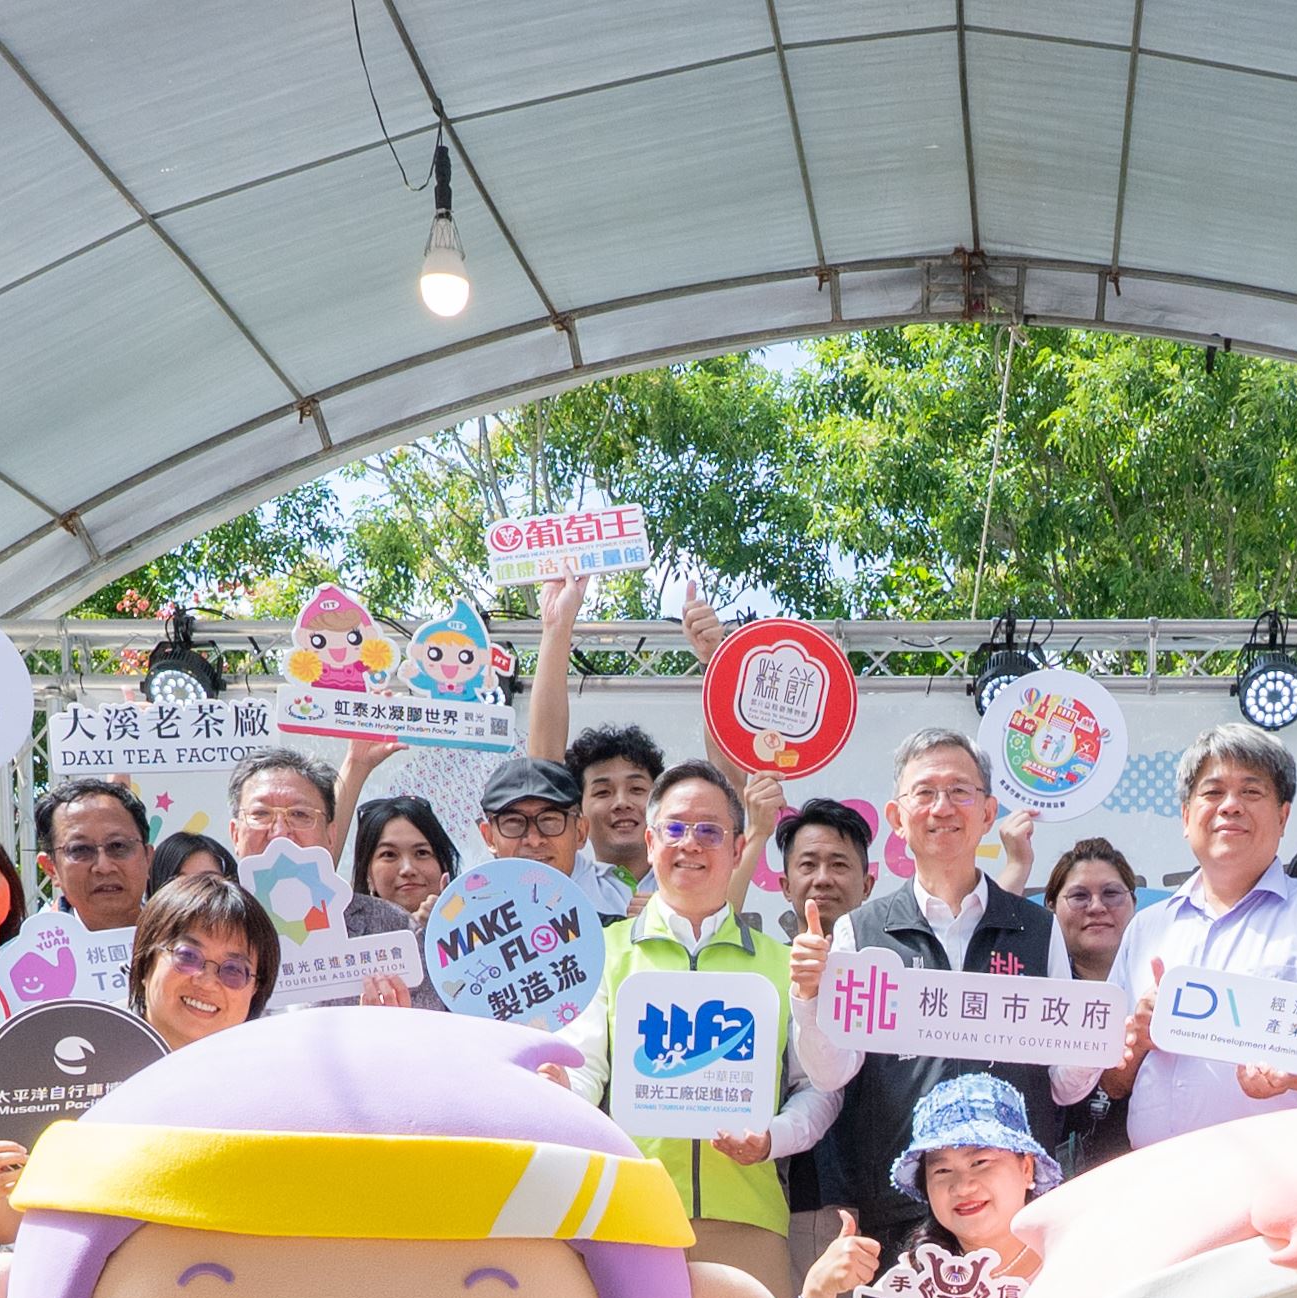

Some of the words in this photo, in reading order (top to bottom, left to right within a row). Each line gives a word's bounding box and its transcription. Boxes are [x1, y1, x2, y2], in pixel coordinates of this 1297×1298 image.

[523, 507, 642, 550] 葡萄王
[59, 702, 270, 742] 大溪老茶廠
[334, 699, 459, 726] 虹泰水凝膠世界
[62, 749, 114, 766] DAXI
[122, 748, 167, 765] TEA
[176, 746, 274, 764] FACTO
[35, 936, 71, 952] YUAN
[437, 899, 523, 969] MAKE
[86, 943, 133, 965] 桃園
[91, 971, 129, 992] Ta
[278, 974, 327, 988] TOURISM
[331, 962, 406, 980] ASSOCIATION
[486, 953, 588, 1021] 製造流
[917, 985, 1112, 1030] 桃園市政府
[917, 1028, 979, 1043] TAOYUAN
[984, 1033, 1014, 1046] CITY
[1018, 1035, 1110, 1052] GOVERNMENT
[1210, 1033, 1267, 1051] Development
[634, 1083, 754, 1103] 觀光工廠促進協會
[889, 1275, 912, 1293] 手
